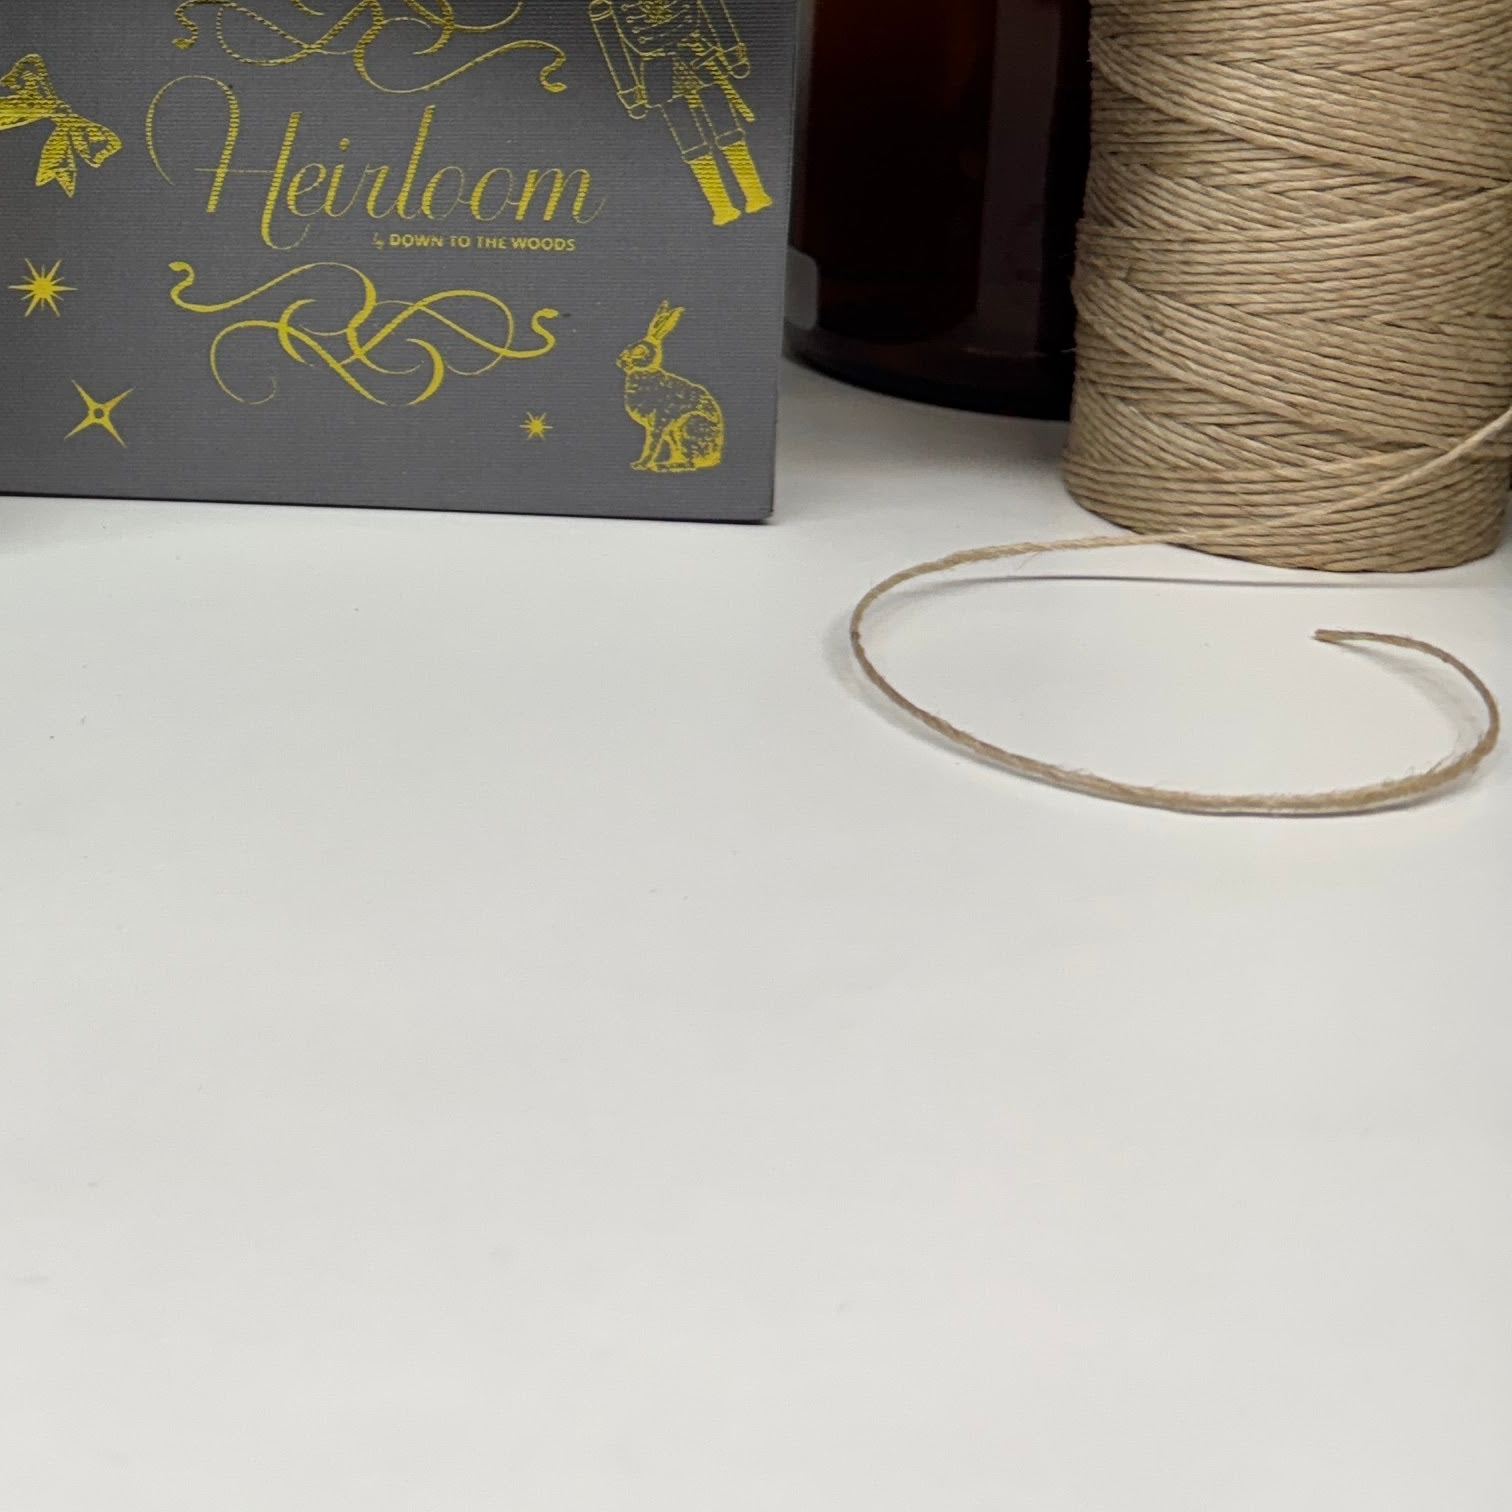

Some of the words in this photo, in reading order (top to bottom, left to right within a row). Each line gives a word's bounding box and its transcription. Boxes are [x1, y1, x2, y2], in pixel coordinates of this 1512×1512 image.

[145, 74, 606, 250] Heirloom
[389, 233, 444, 249] DOWN
[448, 235, 472, 249] TO
[476, 235, 507, 250] THE
[511, 236, 577, 252] WOODS
